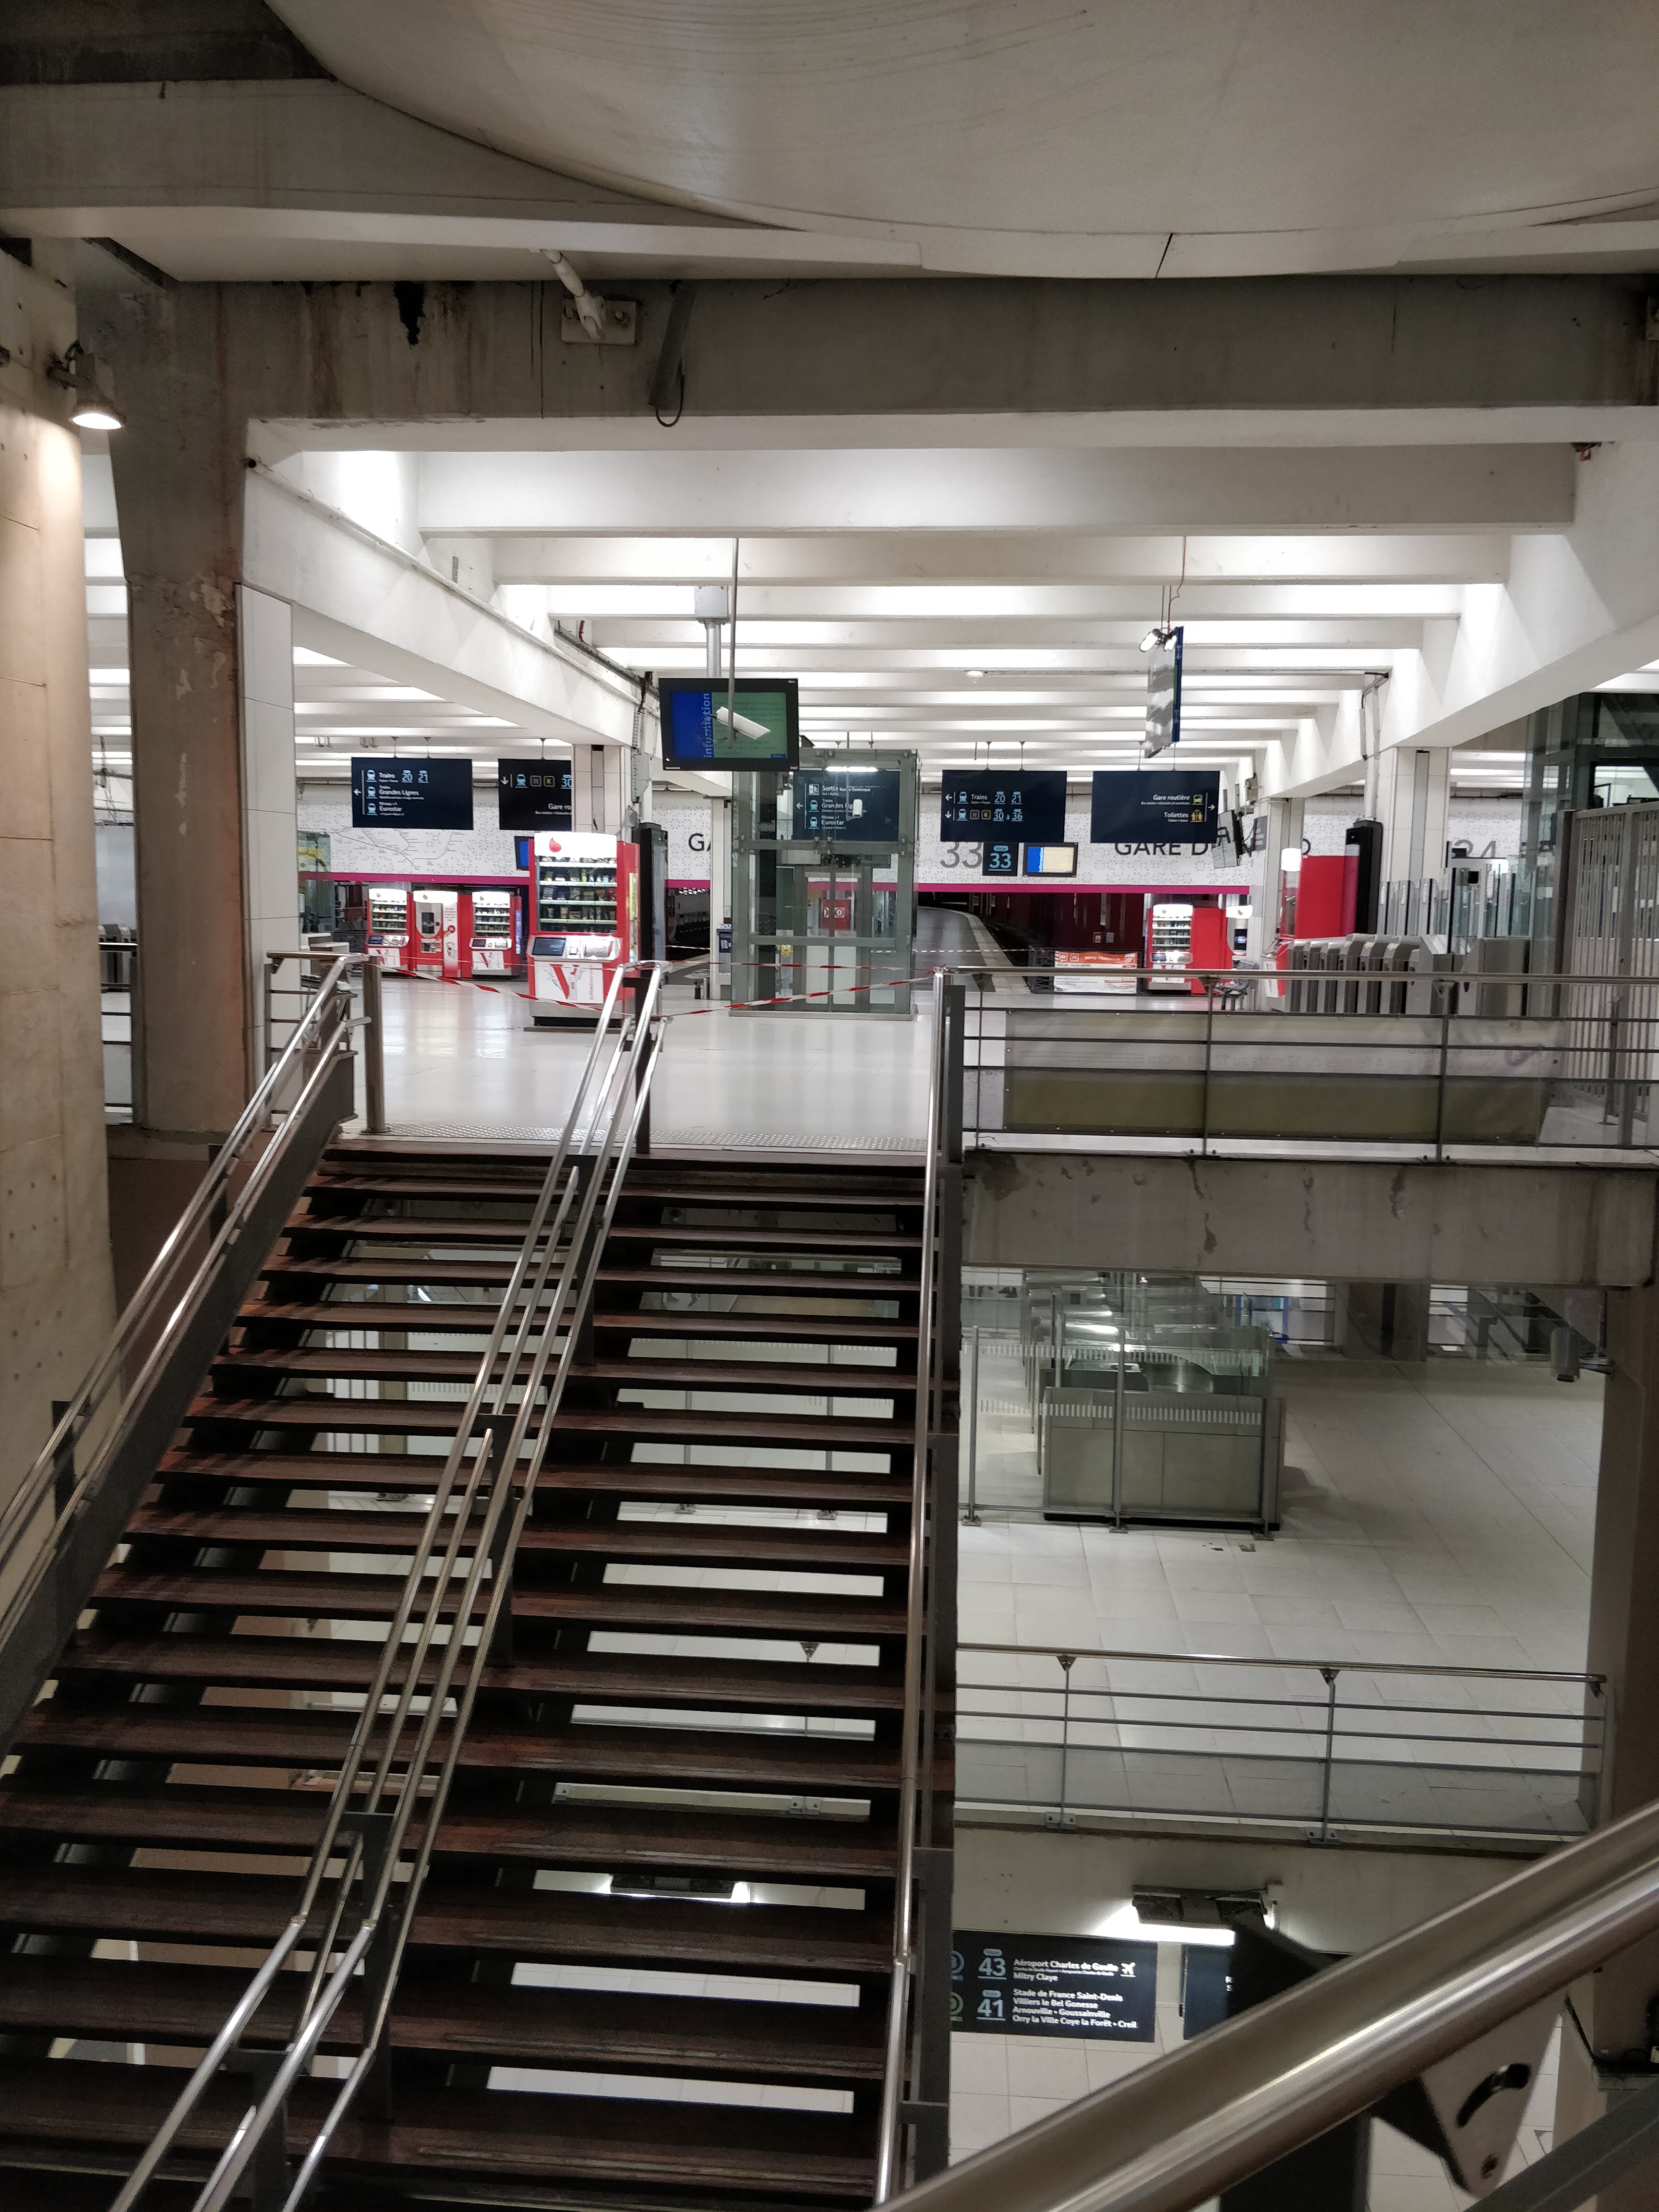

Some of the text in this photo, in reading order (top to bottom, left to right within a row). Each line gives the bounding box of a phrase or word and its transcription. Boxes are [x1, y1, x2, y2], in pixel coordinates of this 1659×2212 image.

[402, 773, 413, 781] 20
[418, 773, 428, 782] 21
[940, 842, 982, 868] 33
[1115, 843, 1181, 855] GARE
[989, 853, 1011, 868] 33
[978, 1957, 1006, 1976] 43
[1013, 1959, 1049, 1968] Aéroport
[1050, 1960, 1079, 1969] Charles
[1092, 1963, 1119, 1972] Gaulle
[1013, 1972, 1058, 1982] Mitry Claye
[1076, 1992, 1123, 2002] Saint-Denis
[977, 1999, 1003, 2017] 41
[1065, 2000, 1098, 2008] Gonesse
[1012, 2007, 1111, 2019] Arnouville Goussainville
[1012, 2015, 1031, 2024] Orry
[1060, 2018, 1080, 2026] Coye
[1090, 2019, 1113, 2027] Forêt
